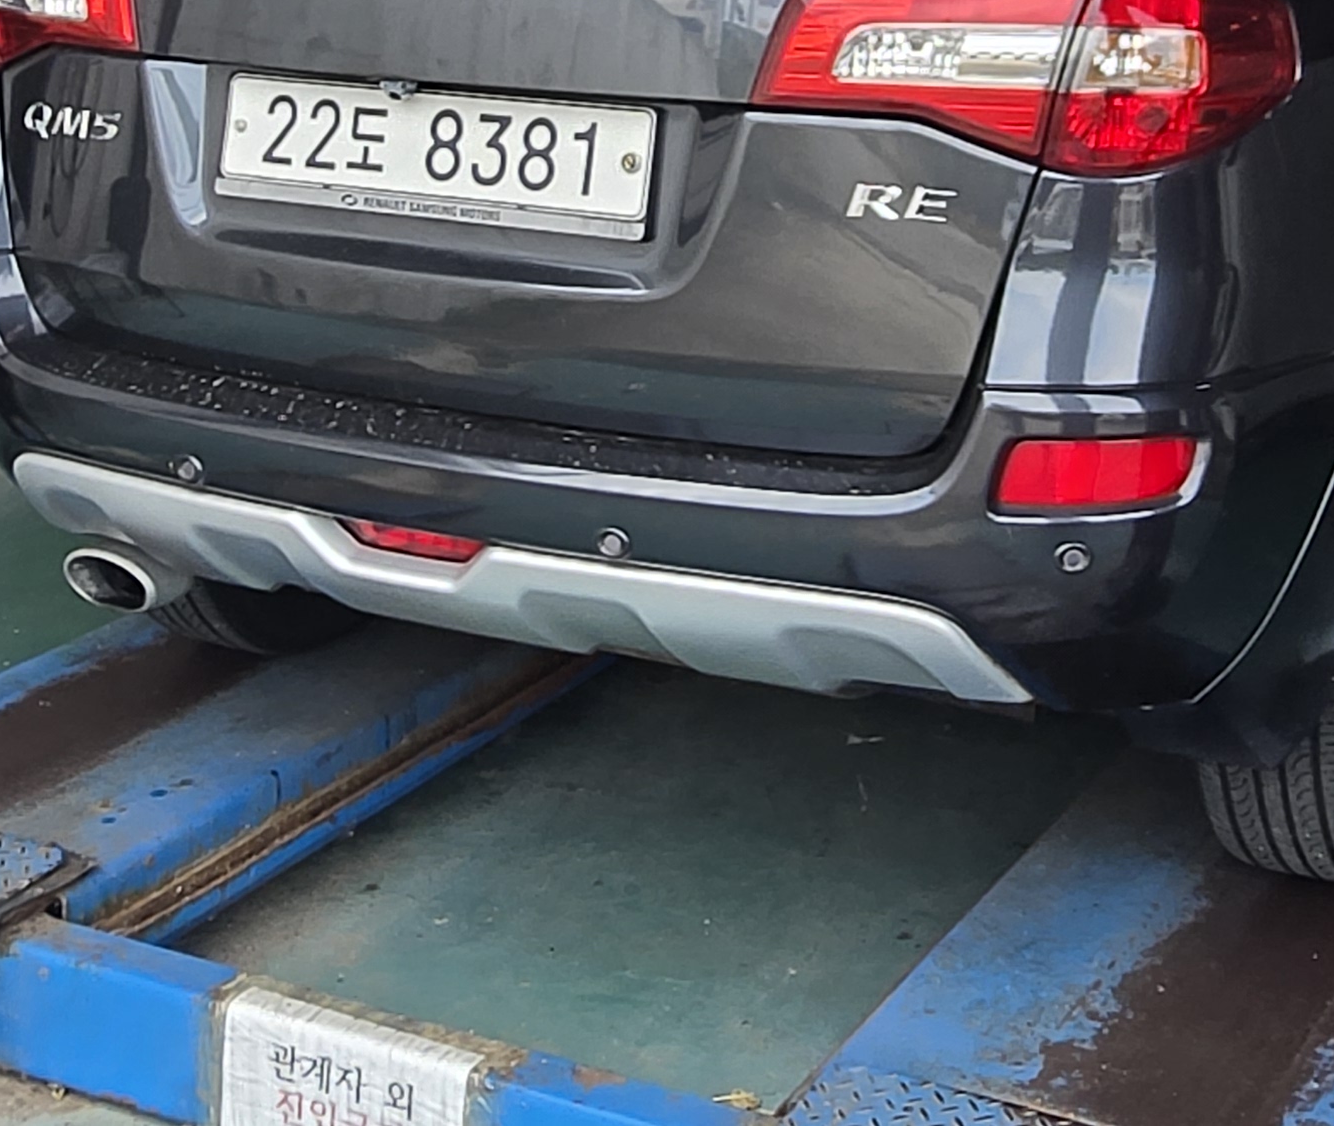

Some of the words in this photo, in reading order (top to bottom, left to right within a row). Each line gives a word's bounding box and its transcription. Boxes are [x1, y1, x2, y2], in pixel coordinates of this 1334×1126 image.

[23, 102, 122, 141] QM5
[260, 94, 389, 172] 22도
[424, 108, 599, 197] 8381
[845, 183, 959, 223] RE
[268, 1042, 368, 1105] 관계자
[383, 1081, 414, 1122] 외
